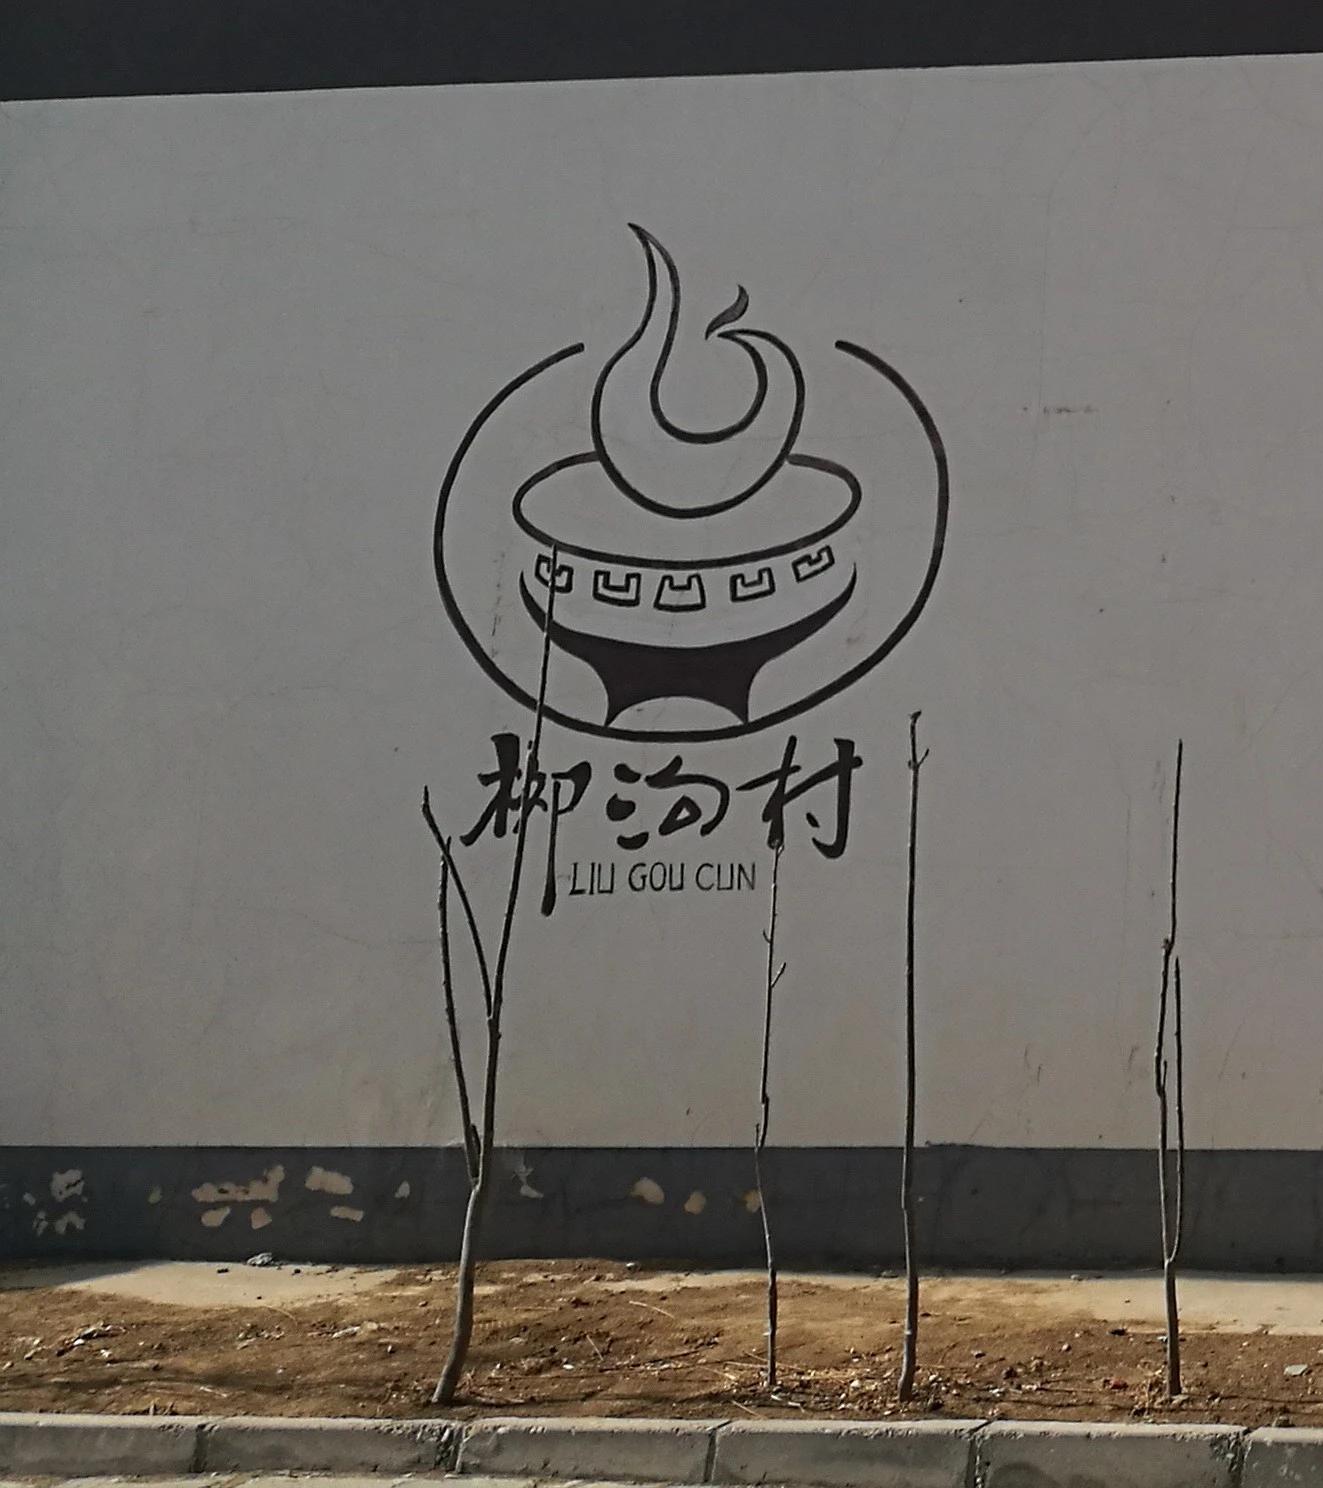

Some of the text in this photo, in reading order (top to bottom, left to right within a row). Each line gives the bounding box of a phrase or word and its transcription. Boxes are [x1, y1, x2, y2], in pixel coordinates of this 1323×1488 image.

[459, 732, 863, 917] 柳沟村
[569, 862, 756, 895] LIU GOU CUN
